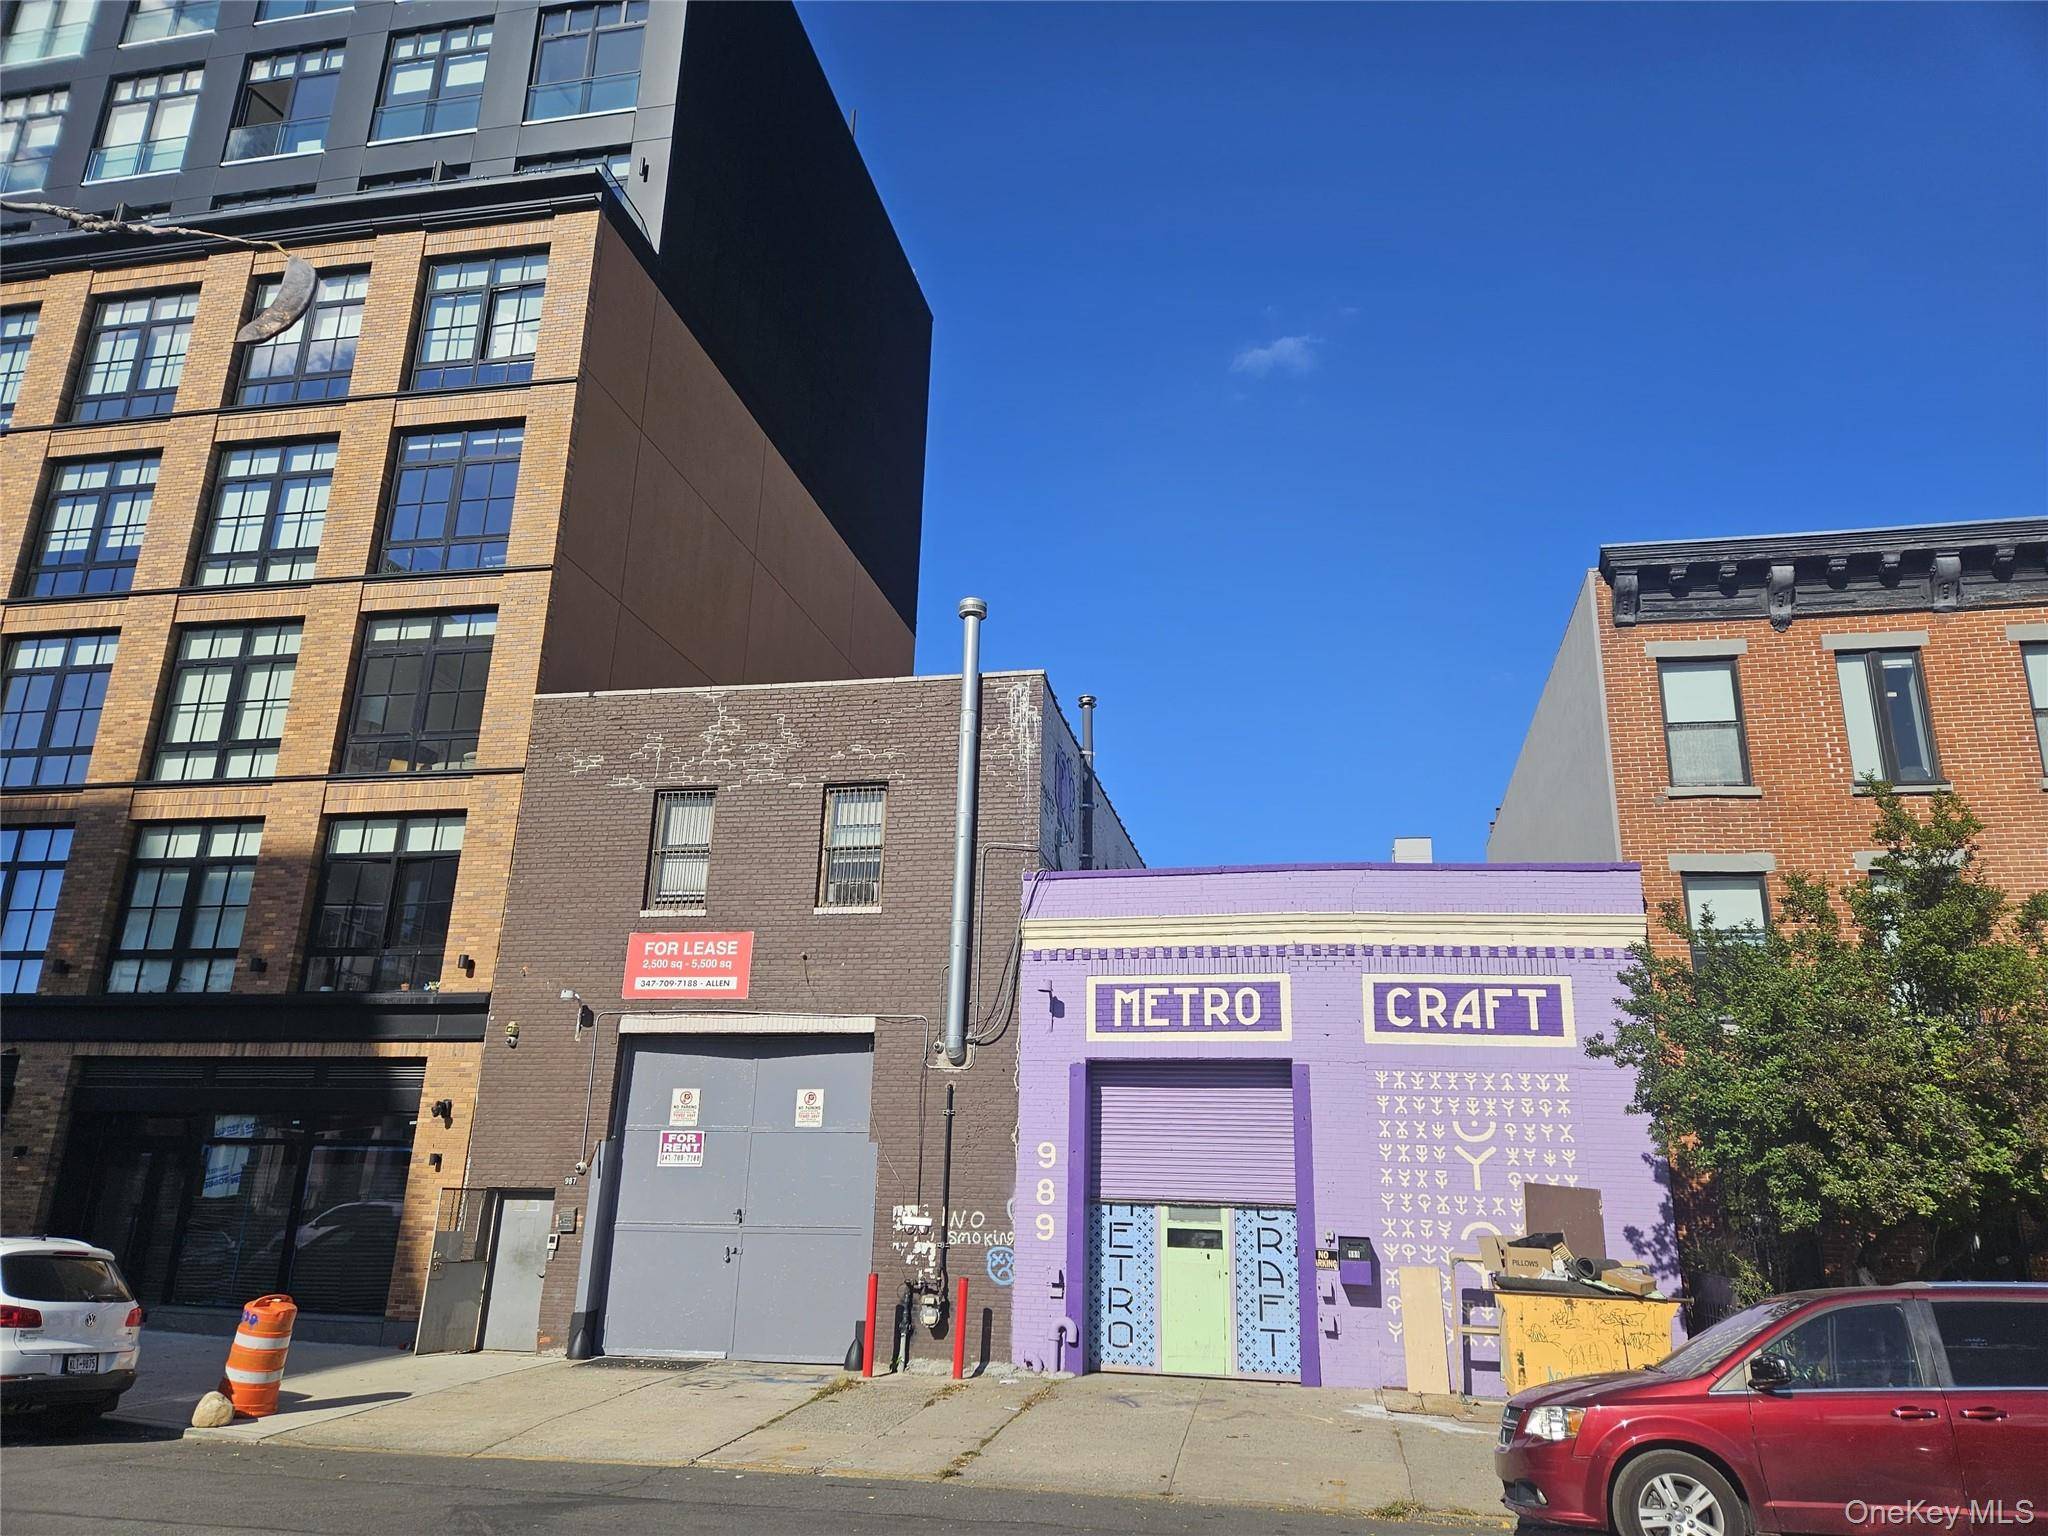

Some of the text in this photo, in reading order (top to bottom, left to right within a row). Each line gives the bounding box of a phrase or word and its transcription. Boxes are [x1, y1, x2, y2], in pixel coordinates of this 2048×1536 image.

[644, 941, 739, 956] FOR LEASE
[642, 959, 669, 970] 2,500
[670, 960, 683, 971] sq
[691, 959, 718, 970] 5,500
[719, 960, 732, 971] sq
[640, 979, 698, 988] 347-709-7188
[705, 979, 731, 988] ALLEN
[1113, 986, 1262, 1027] METRO
[1386, 986, 1548, 1032] CRAFT
[668, 1133, 698, 1143] FOR
[663, 1142, 701, 1153] RENT
[1036, 1141, 1057, 1242] 989
[949, 1209, 986, 1229] NO
[1317, 1250, 1330, 1260] NO
[1511, 1258, 1540, 1269] PILLOWS
